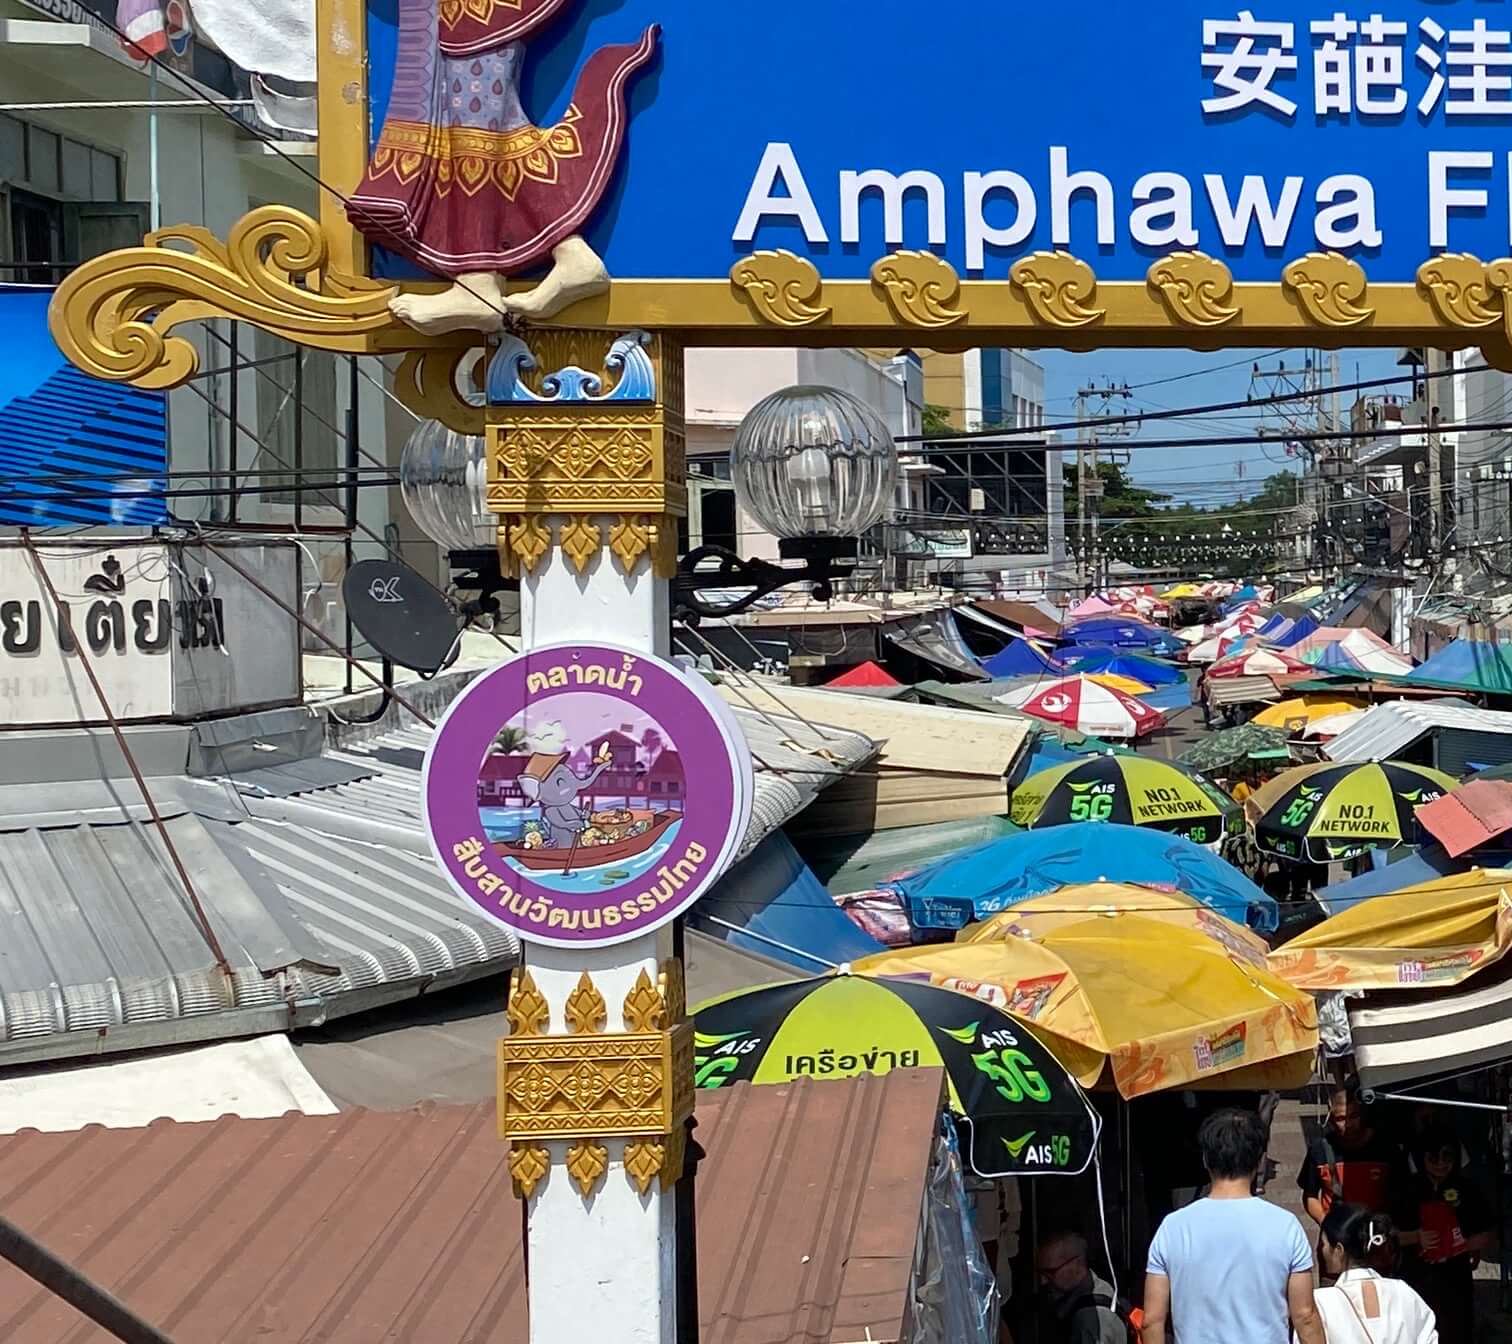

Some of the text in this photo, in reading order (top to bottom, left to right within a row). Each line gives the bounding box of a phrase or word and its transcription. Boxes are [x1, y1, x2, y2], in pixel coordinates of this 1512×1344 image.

[731, 142, 1382, 270] Amphawa
[526, 654, 644, 697] ตลาดน้ำ
[1091, 783, 1116, 794] AIS
[1143, 787, 1183, 803] NO.1
[1306, 791, 1324, 802] AIS
[1421, 791, 1441, 802] AIS
[1068, 793, 1113, 822] 5G
[1137, 799, 1208, 818] NETWORK
[1280, 798, 1315, 827] 5G
[1338, 804, 1375, 820] NO.1
[1320, 820, 1390, 833] NETWORK
[452, 836, 708, 931] สืบสานวัฒนธรรมไทย
[713, 1037, 762, 1056] AIS
[981, 1029, 1017, 1049] AIS
[784, 1046, 920, 1075] เครือข่าย
[694, 1056, 740, 1089] G
[970, 1047, 1053, 1104] 5G
